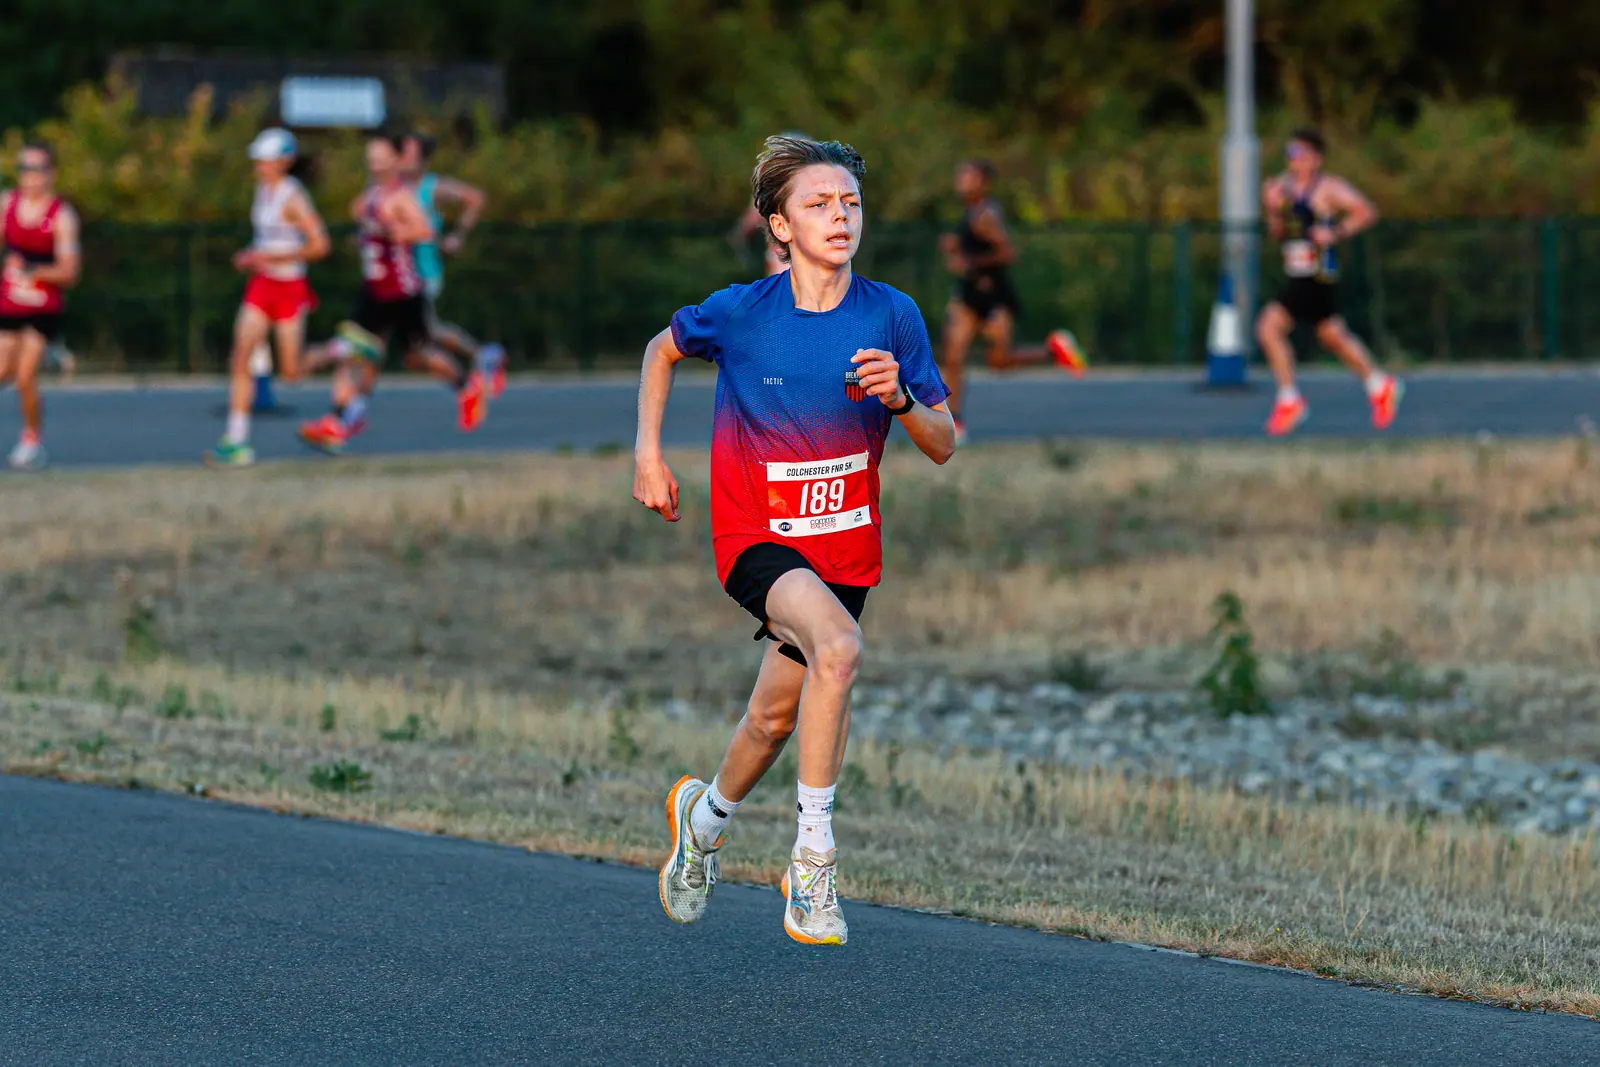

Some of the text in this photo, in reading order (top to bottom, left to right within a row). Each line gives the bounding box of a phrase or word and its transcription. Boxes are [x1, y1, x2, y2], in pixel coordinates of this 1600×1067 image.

[786, 461, 853, 477] COLCHESTER FNR 5K
[800, 478, 845, 516] 189
[810, 516, 836, 524] comms
